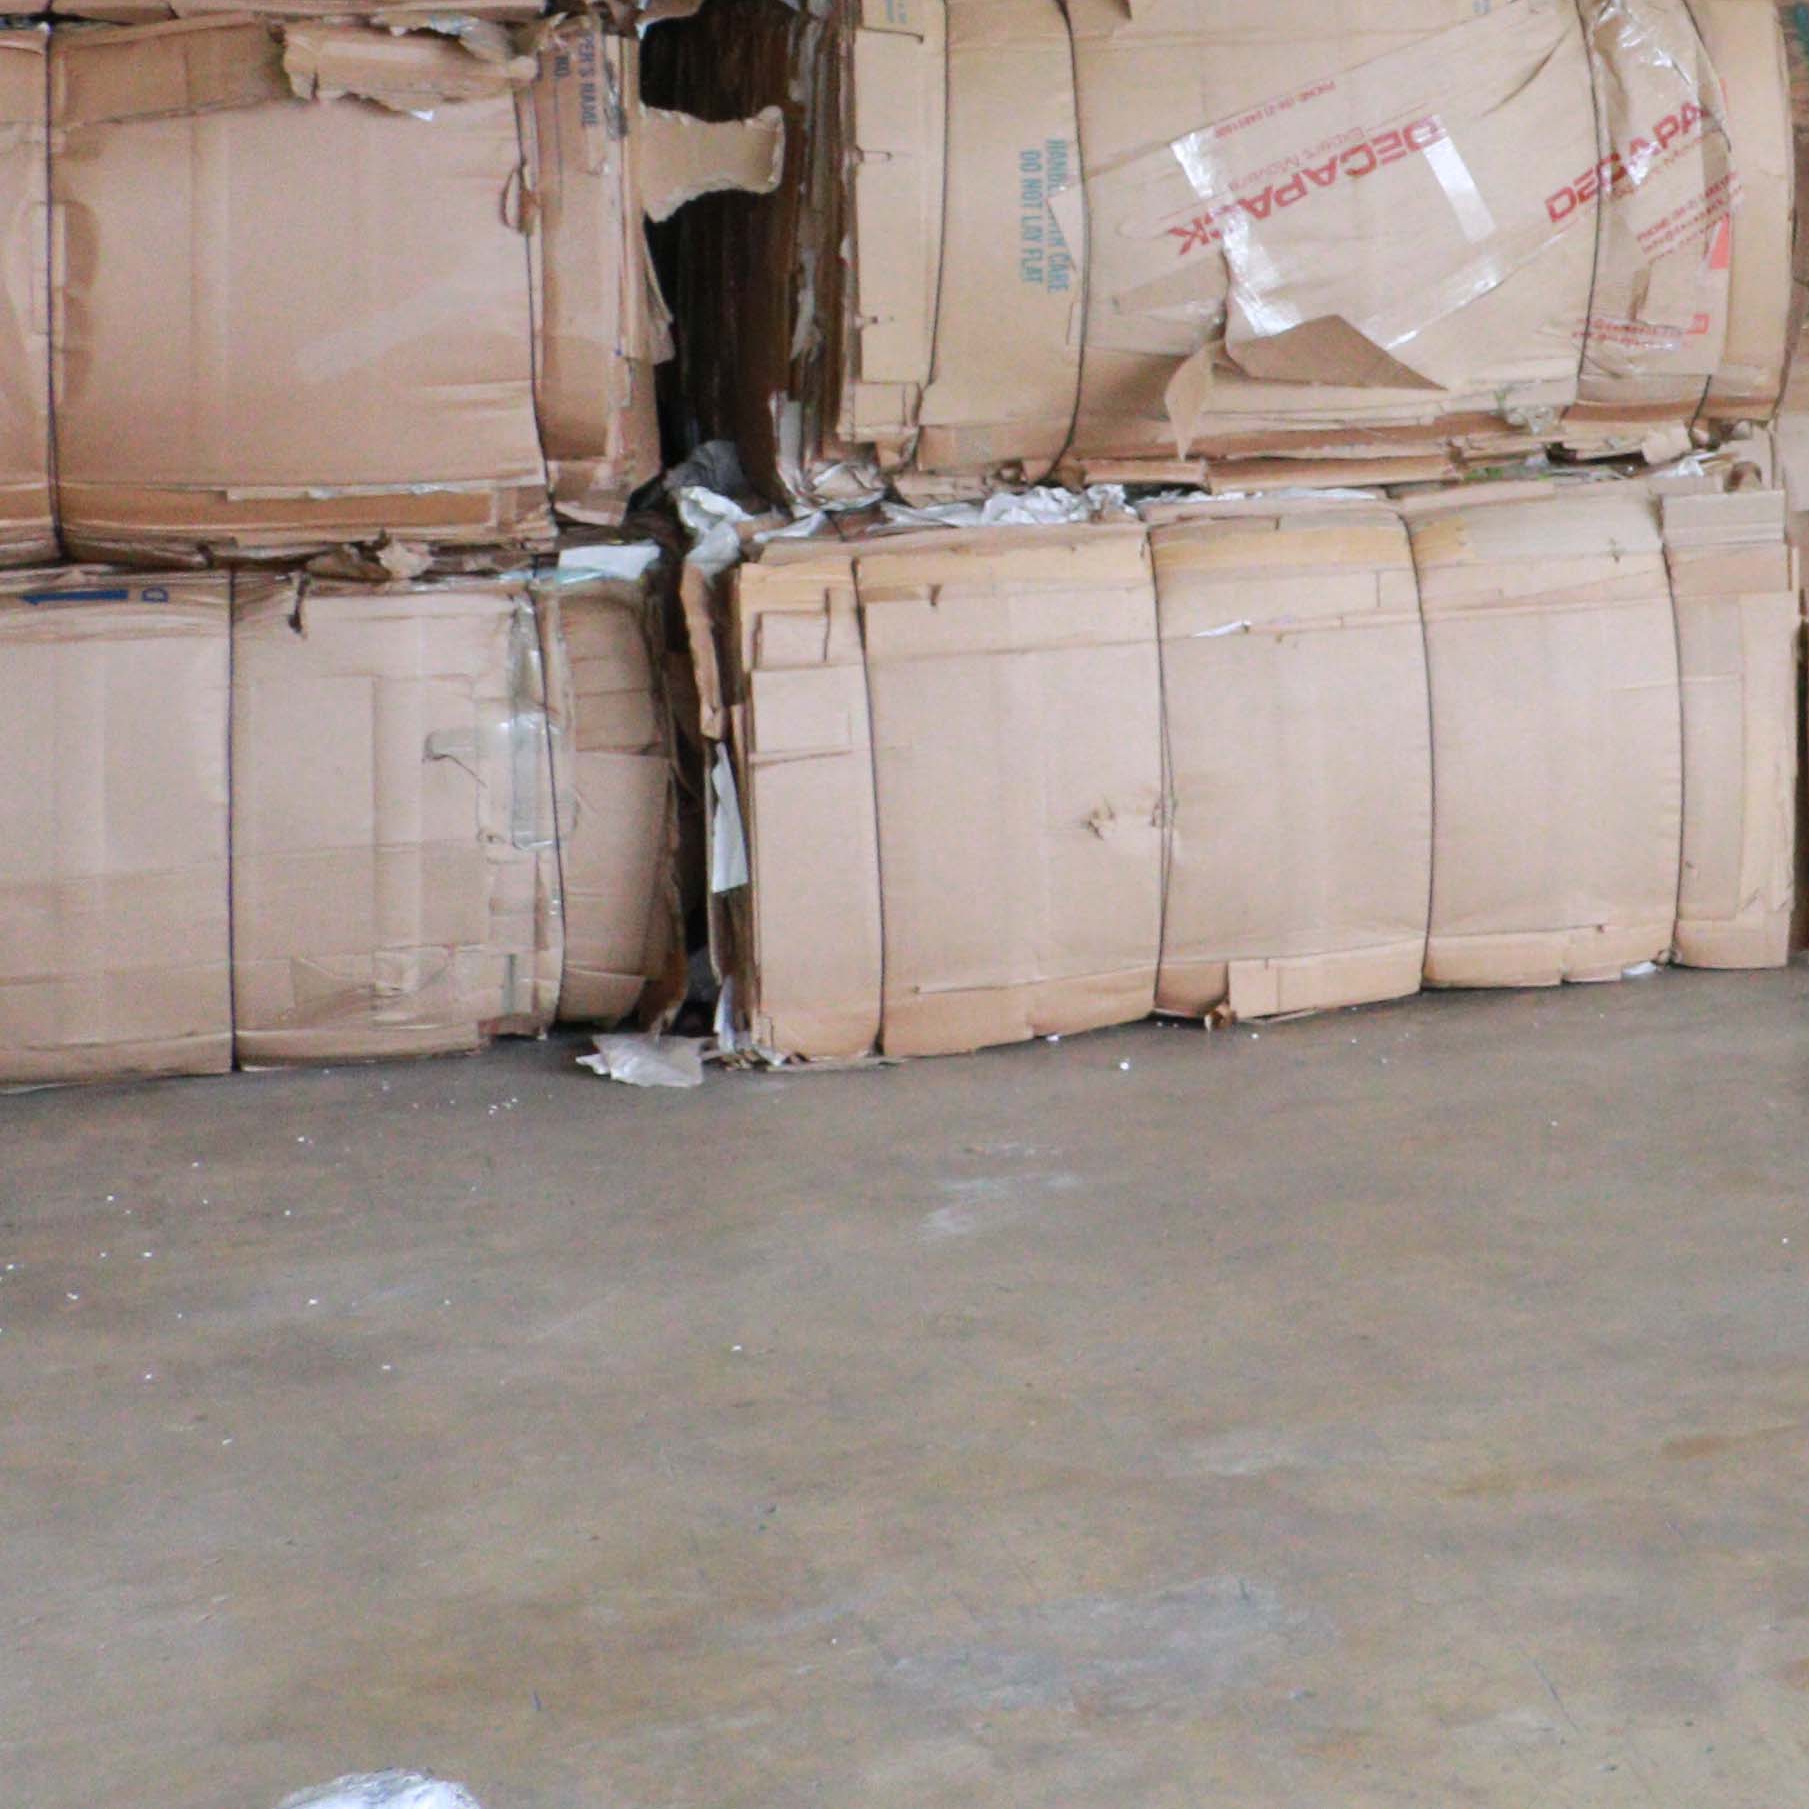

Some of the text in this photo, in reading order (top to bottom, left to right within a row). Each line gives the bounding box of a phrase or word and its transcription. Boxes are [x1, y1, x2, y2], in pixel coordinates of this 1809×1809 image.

[1021, 149, 1044, 283] DO NOT LAY FLAT
[1046, 139, 1069, 201] HANDL
